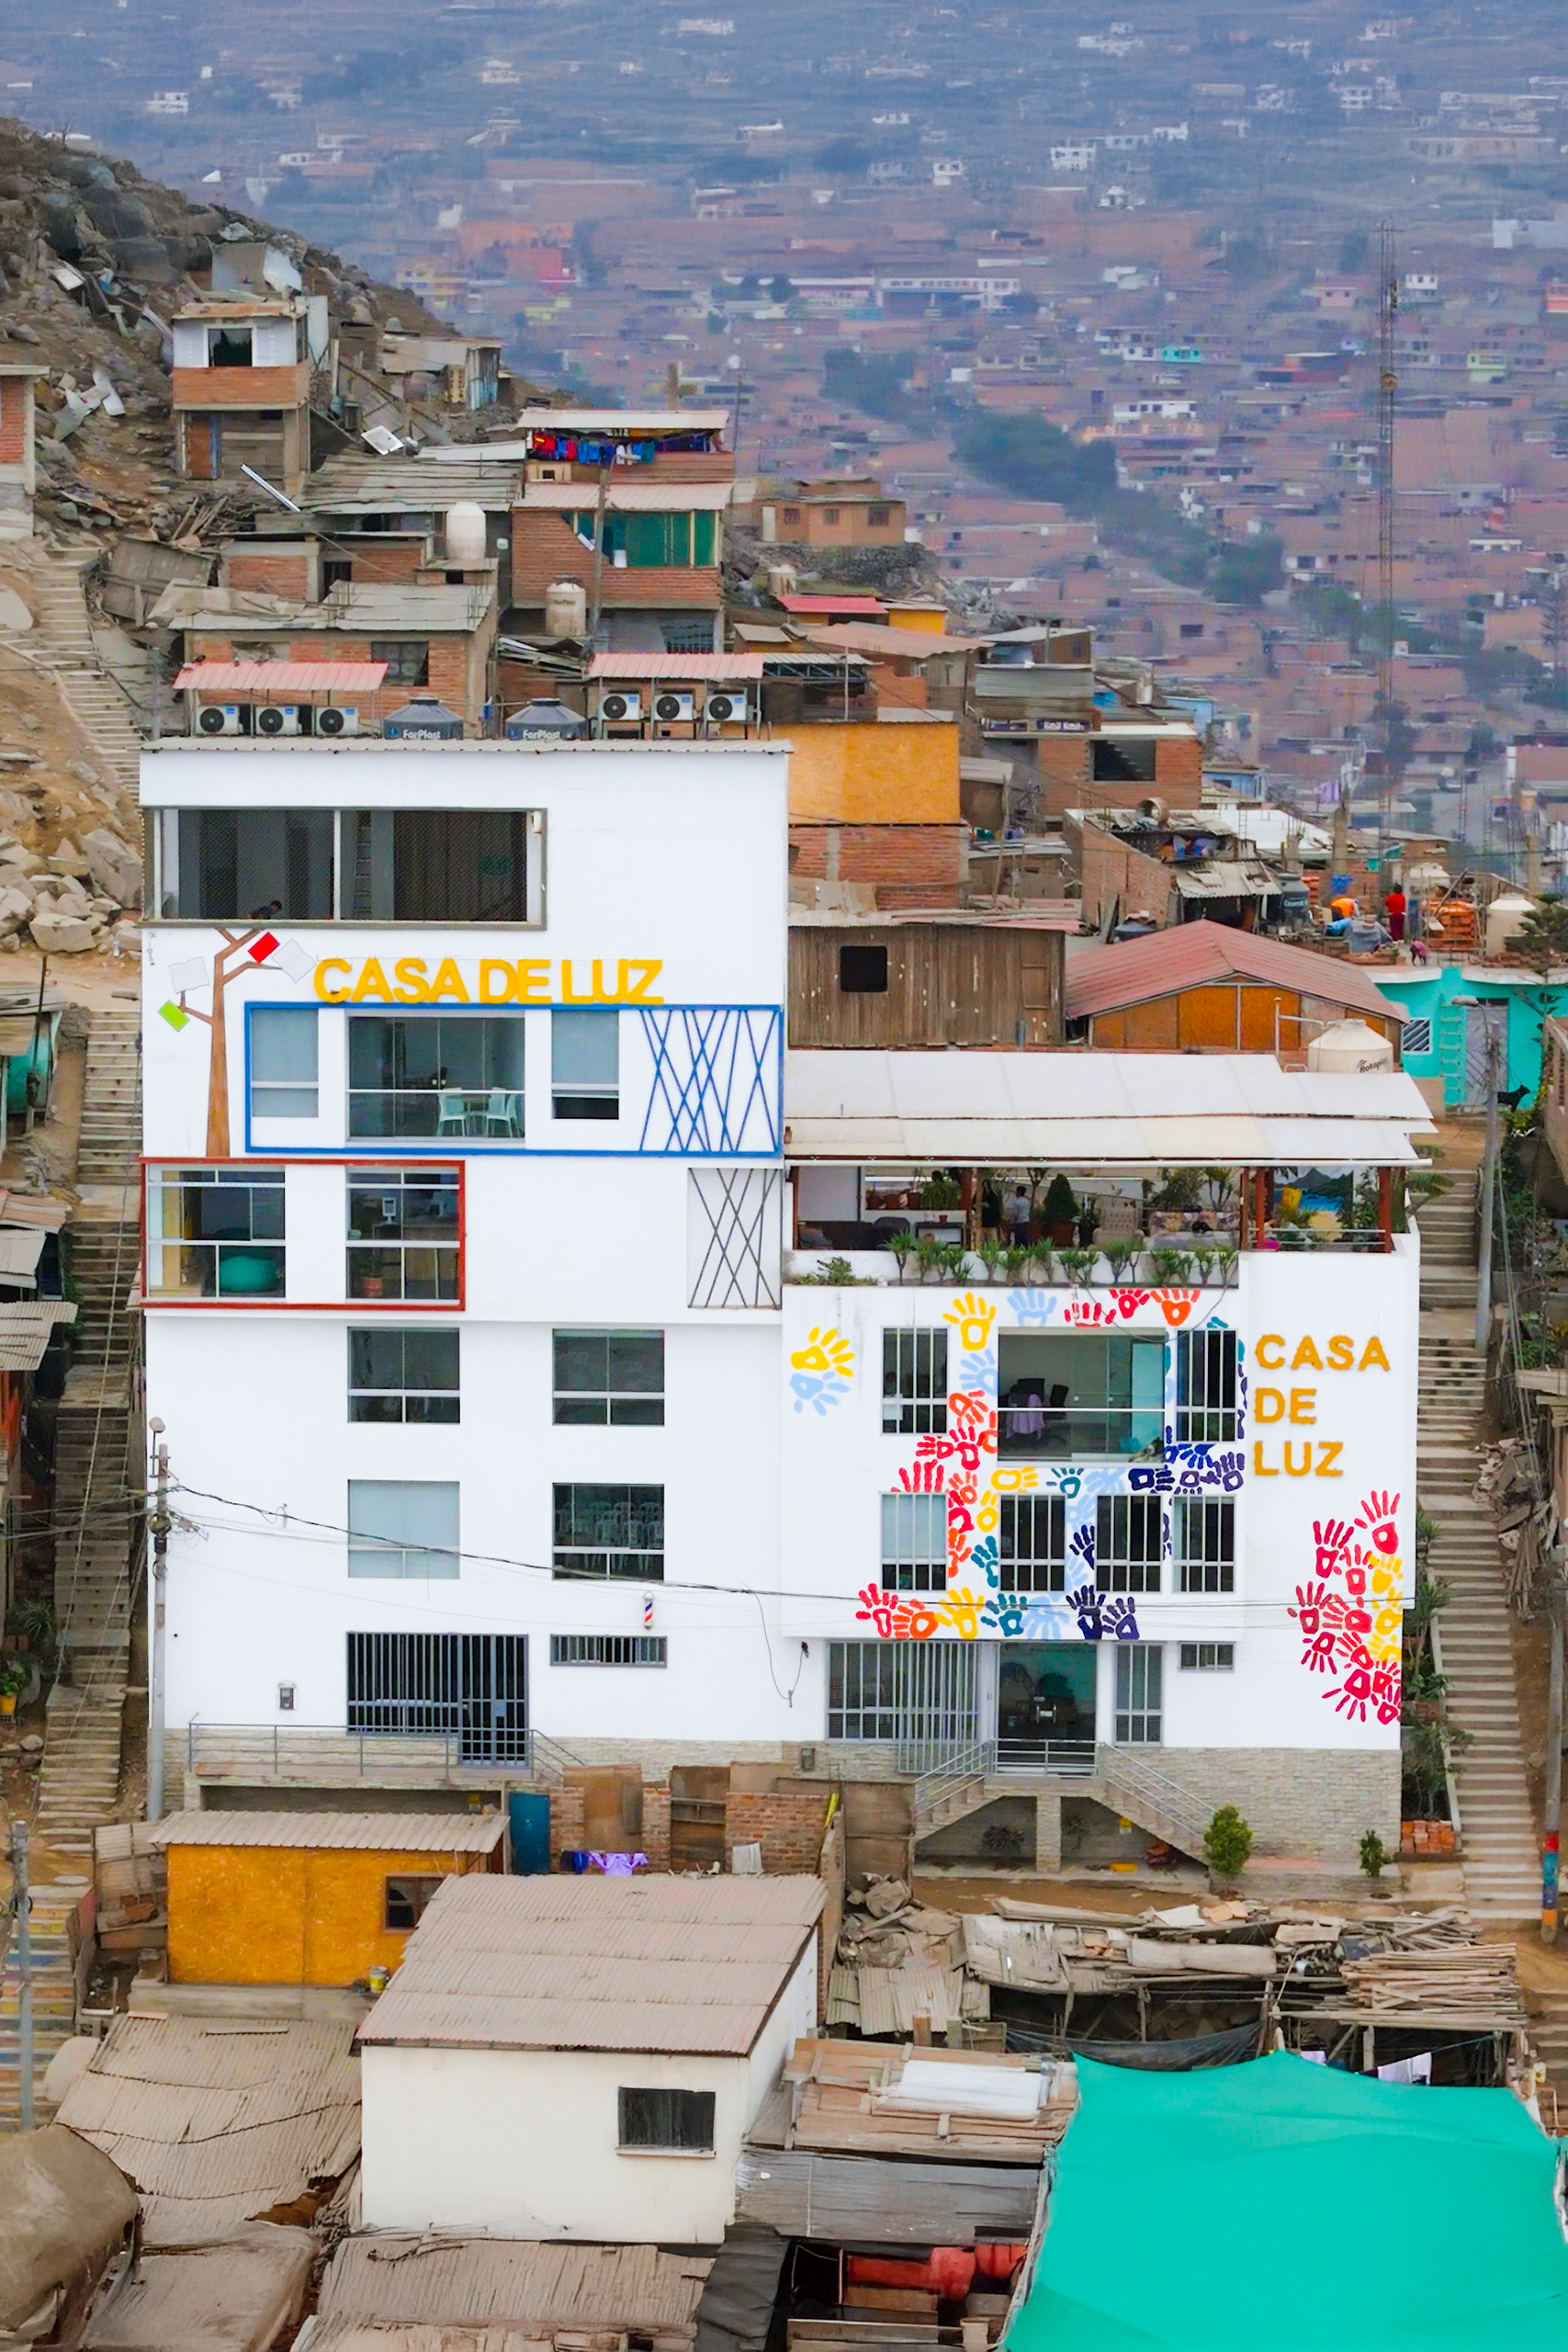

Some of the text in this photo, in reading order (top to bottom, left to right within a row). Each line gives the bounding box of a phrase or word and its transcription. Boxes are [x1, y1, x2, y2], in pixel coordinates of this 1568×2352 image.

[403, 729, 441, 739] FarPlast
[313, 957, 664, 1004] CASA DE LUZ
[1255, 1334, 1390, 1371] CASA
[1254, 1387, 1317, 1424] DE
[1254, 1440, 1344, 1477] LUZ
